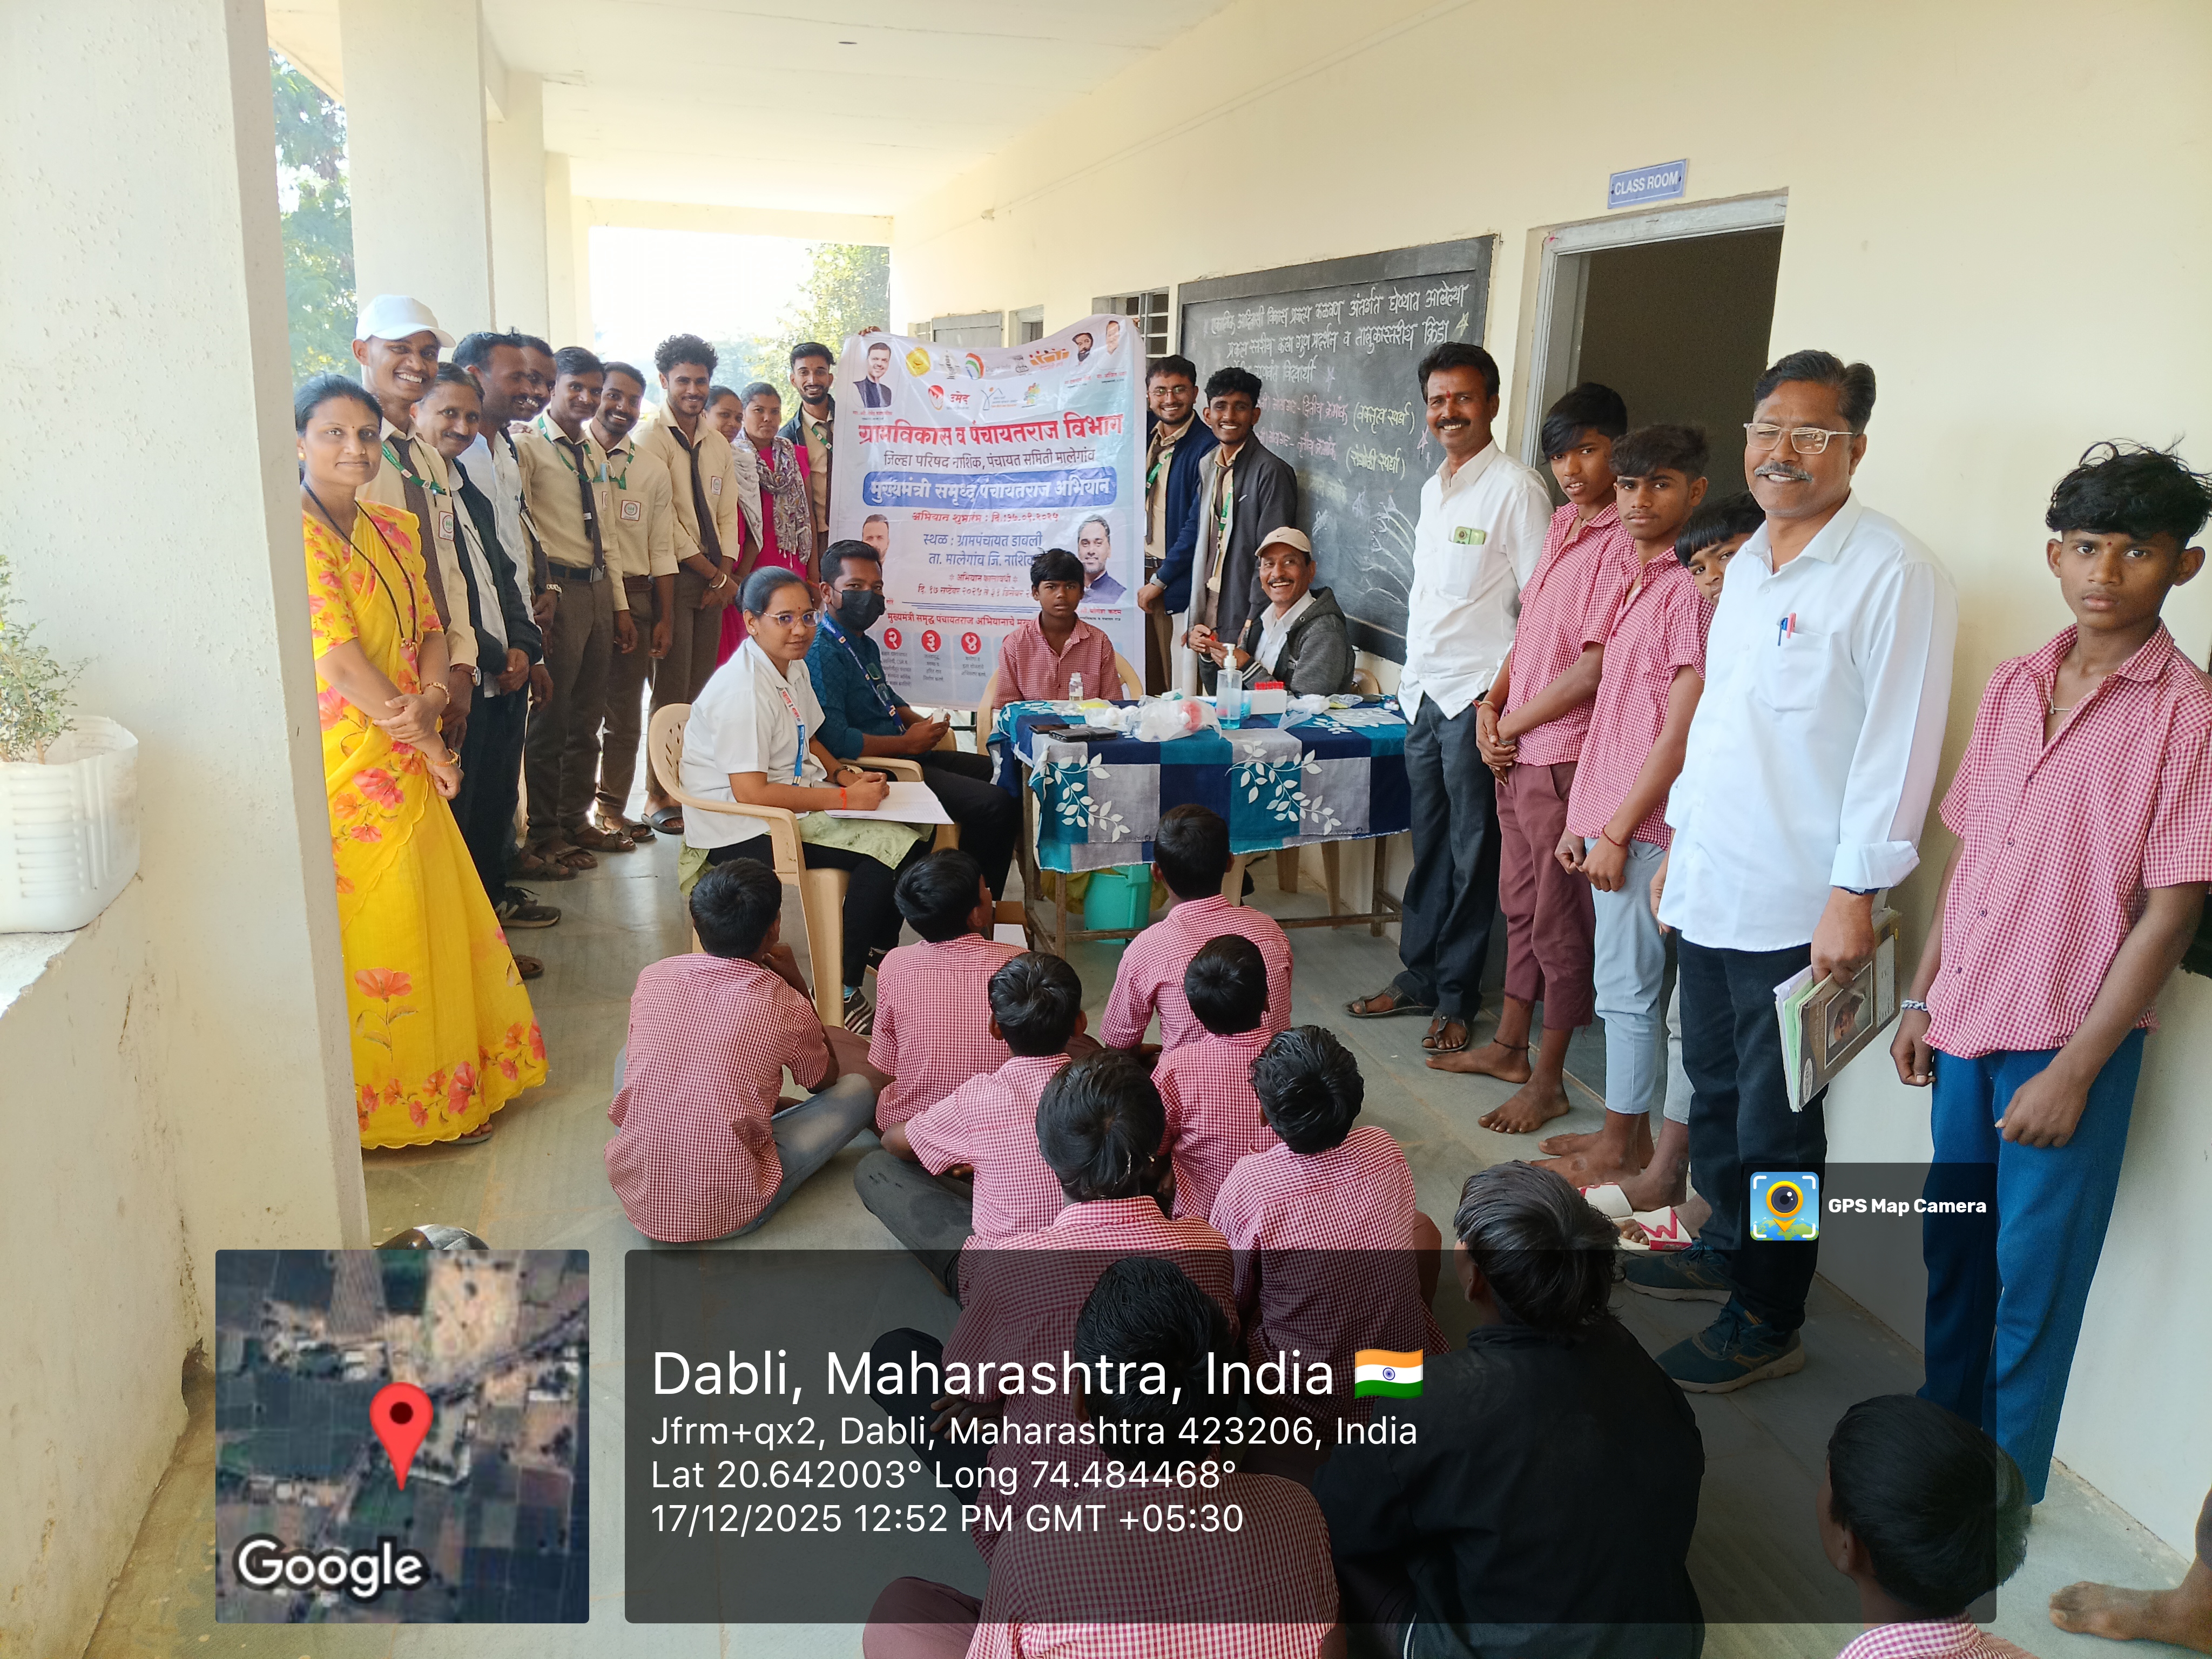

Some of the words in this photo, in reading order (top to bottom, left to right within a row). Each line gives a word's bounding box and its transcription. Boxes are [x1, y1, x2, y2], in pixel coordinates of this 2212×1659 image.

[1614, 177, 1645, 195] CLASS
[1647, 171, 1678, 190] ROOM
[1348, 286, 1384, 317] अंतर्गत
[1425, 280, 1469, 307] आलेल्या
[1343, 331, 1351, 346] व
[1355, 319, 1419, 355] तालुकास्तरीय
[859, 419, 952, 446] ग्रामविकास
[955, 427, 966, 445] व
[969, 420, 1059, 445] पंचायतराज
[1063, 412, 1124, 440] विभाग
[884, 450, 913, 467] जिल्हा
[916, 453, 950, 468] परिषद
[953, 453, 986, 470] नाशिक,
[987, 453, 1021, 468] पंचायत
[1022, 448, 1053, 466] समिती
[1055, 447, 1096, 464] मालेगांव
[870, 477, 932, 504] मुख्यमंत्री
[1055, 474, 1110, 496] अभियान
[912, 510, 950, 522] अभियान
[923, 534, 948, 545] स्थळ
[957, 532, 1009, 547] ग्रामपंचायत
[1011, 531, 1043, 547] डाबली
[929, 553, 942, 564] ता.
[946, 551, 986, 566] मालेगांव
[988, 551, 1001, 566] जि.
[887, 612, 914, 624] मुख्यमंत्री
[936, 614, 974, 625] पंचायतराज
[976, 615, 1014, 626] अभियानाचे
[888, 631, 898, 648] २
